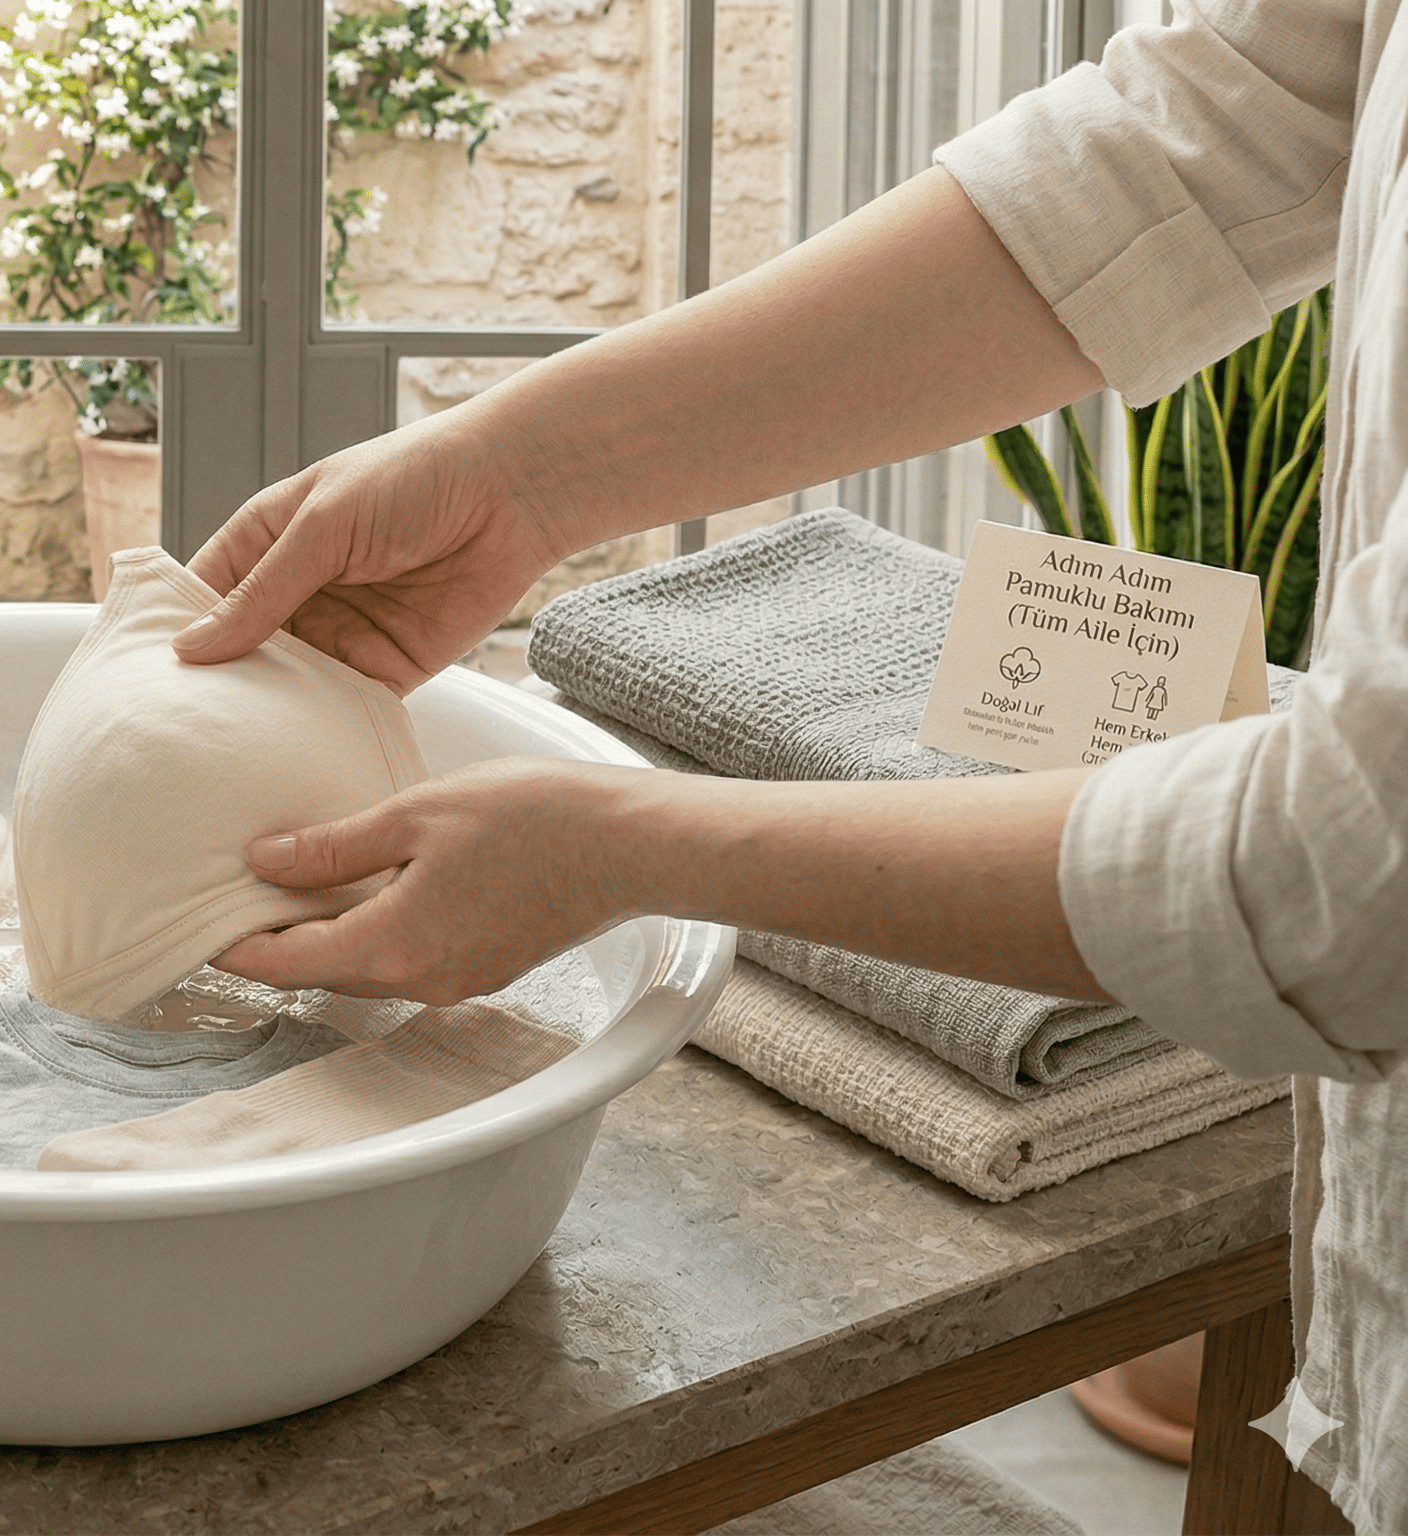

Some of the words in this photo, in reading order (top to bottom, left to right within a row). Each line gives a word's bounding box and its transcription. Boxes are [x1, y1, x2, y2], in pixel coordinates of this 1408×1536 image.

[1040, 550, 1103, 580] Adım
[1108, 563, 1172, 594] Adım
[1005, 571, 1106, 611] Pamuklu
[1113, 593, 1195, 629] Bakımı
[1007, 603, 1068, 633] (Tüm
[1073, 616, 1120, 644] Aile
[1127, 623, 1180, 662] İçin)
[1091, 735, 1123, 753] Hem
[1094, 717, 1126, 736] Hem
